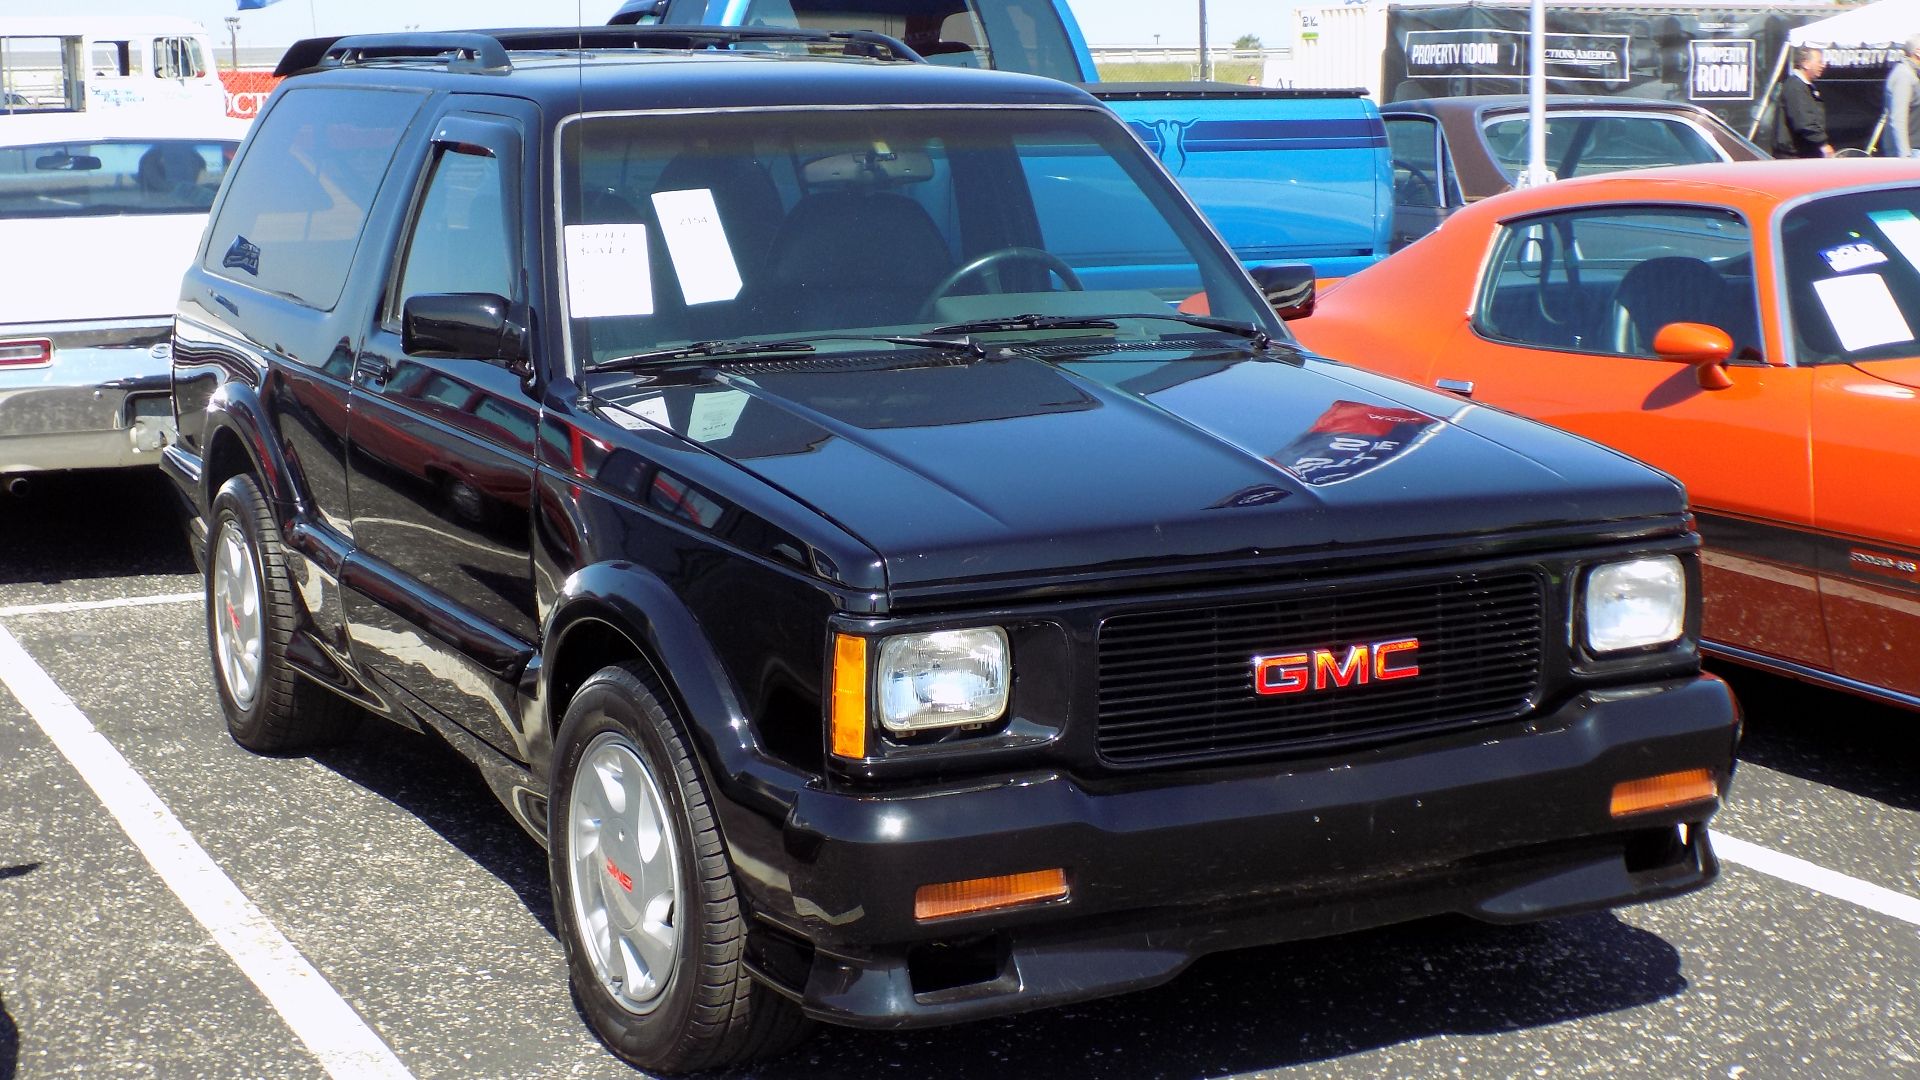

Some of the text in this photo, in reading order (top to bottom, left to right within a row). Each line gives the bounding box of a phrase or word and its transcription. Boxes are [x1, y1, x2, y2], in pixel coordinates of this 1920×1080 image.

[1412, 43, 1498, 64] PROPERTY ROOM
[1544, 48, 1617, 60] CTIONS AMERICA
[1698, 47, 1748, 62] PROPERTY
[1696, 65, 1748, 92] ROOM
[1254, 638, 1419, 695] GMC
